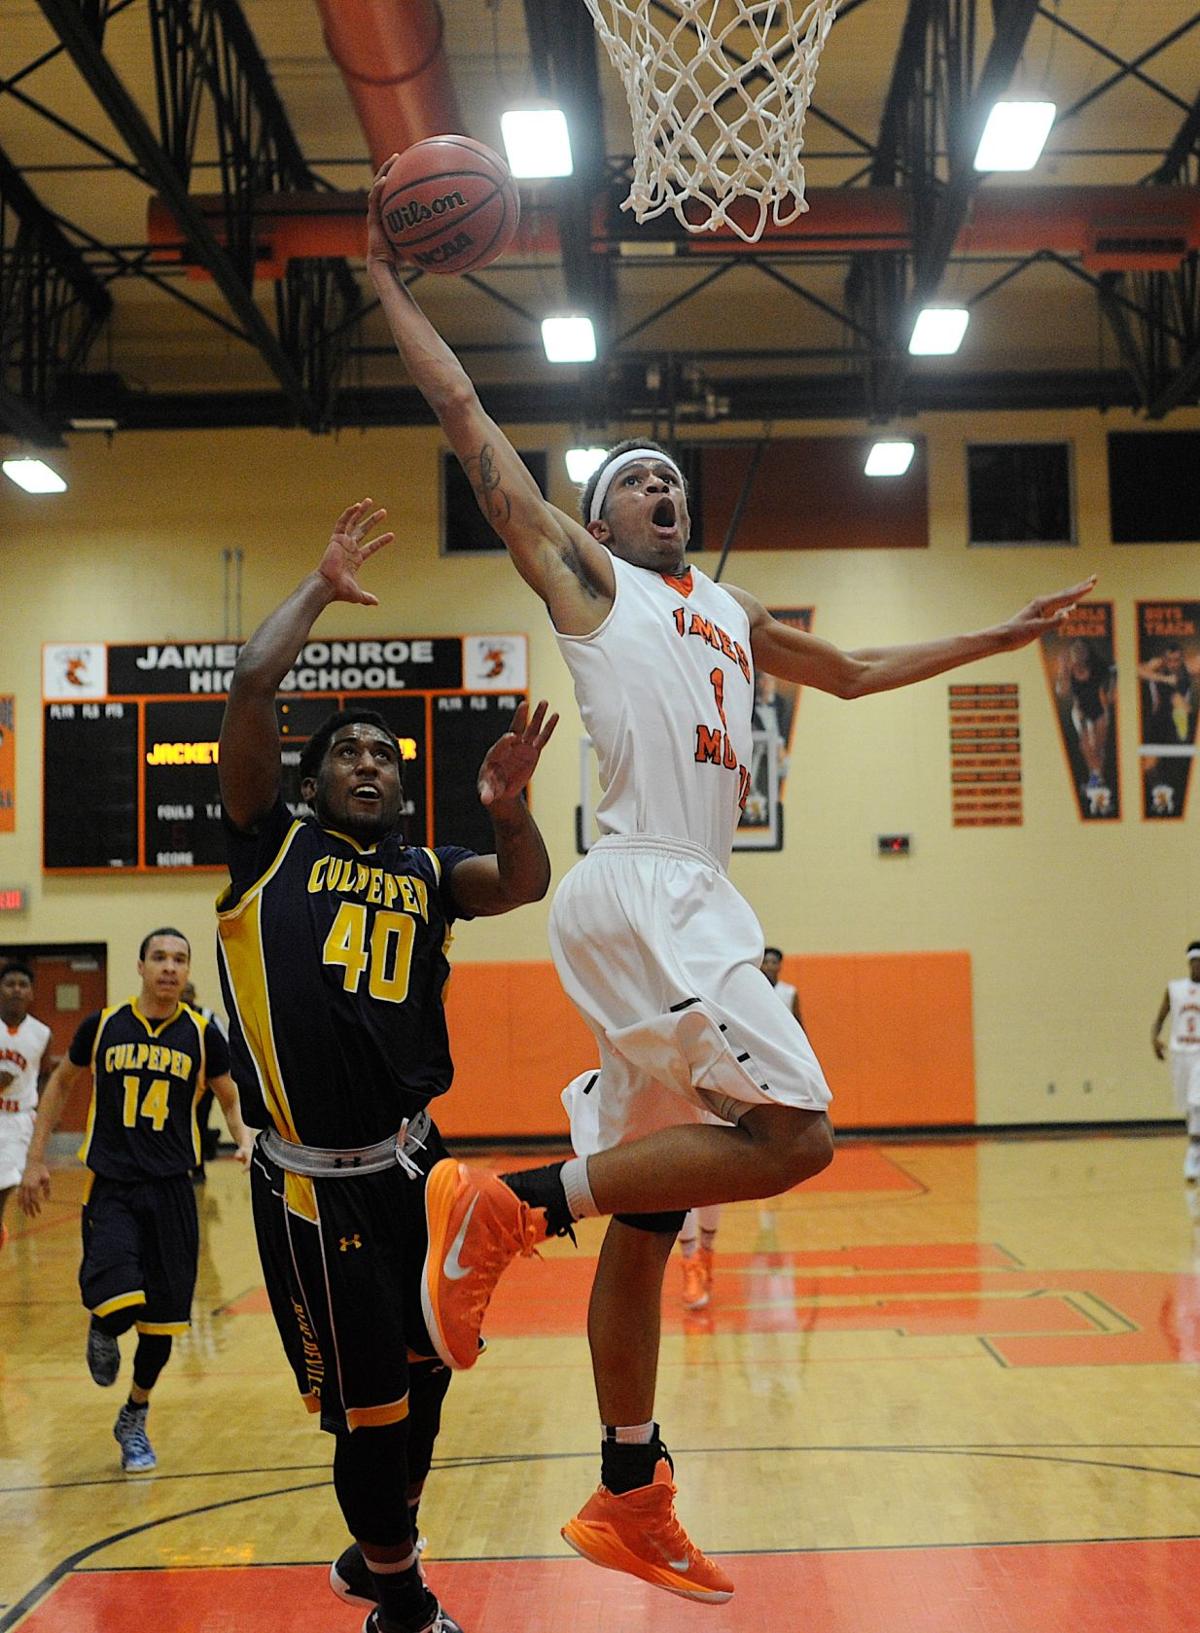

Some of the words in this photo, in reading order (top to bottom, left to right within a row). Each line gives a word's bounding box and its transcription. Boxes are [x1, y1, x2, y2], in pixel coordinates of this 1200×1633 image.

[385, 190, 468, 234] Wilson
[415, 234, 473, 265] NCAA
[136, 644, 246, 670] JAME
[279, 667, 405, 691] SCHOOL
[146, 742, 219, 765] JACKET
[157, 804, 194, 820] FOULS
[157, 852, 194, 868] SCORE
[307, 854, 429, 925] CULPEPER
[322, 901, 417, 1004] 40
[105, 1043, 193, 1081] CULPEPER
[123, 1075, 170, 1131] 14
